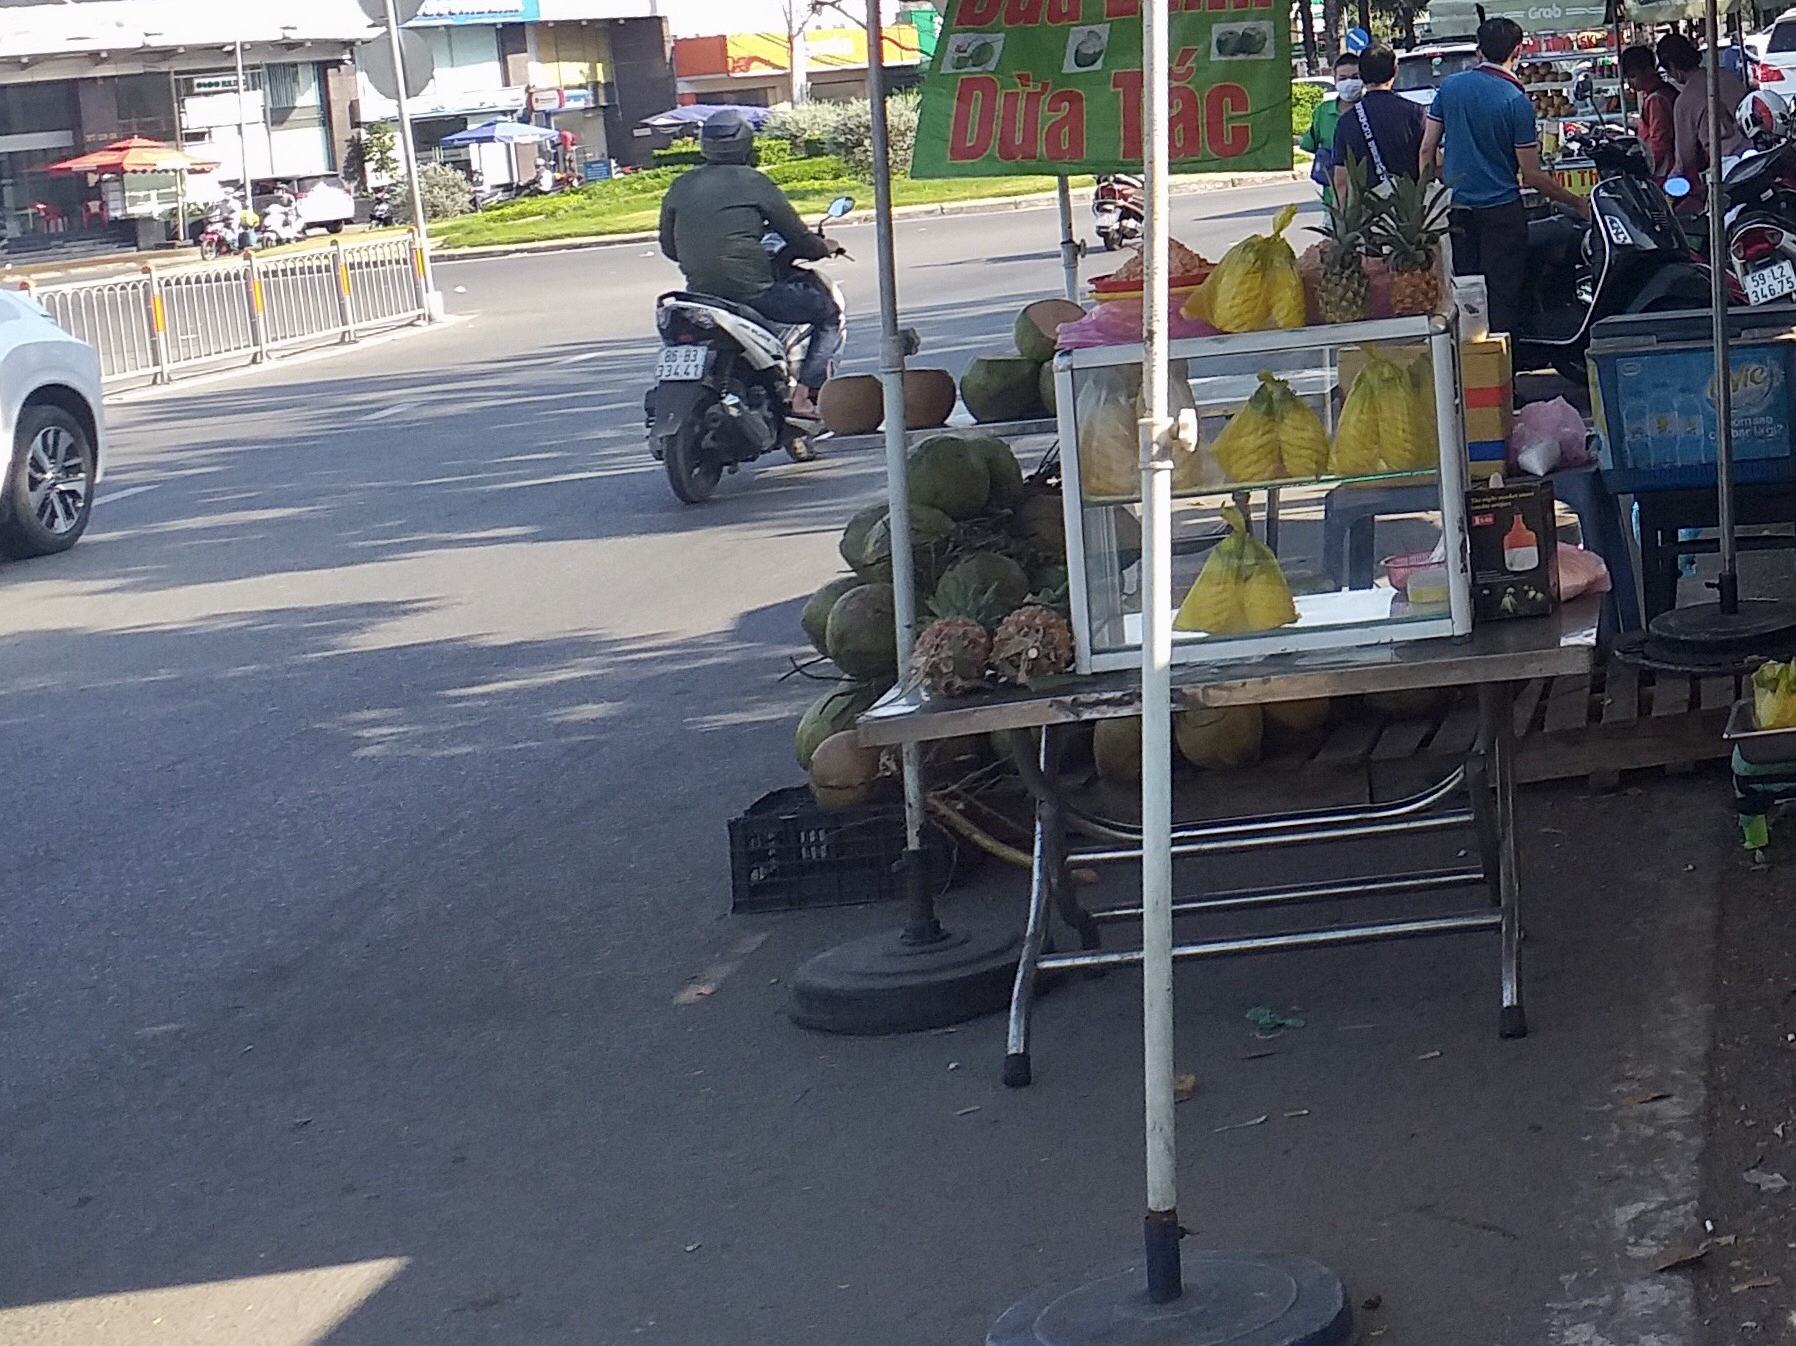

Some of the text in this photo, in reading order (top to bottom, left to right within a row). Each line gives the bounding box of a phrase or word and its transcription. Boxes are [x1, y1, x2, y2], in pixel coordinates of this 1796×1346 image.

[1528, 4, 1562, 20] Grab
[948, 71, 1086, 163] Dừa
[1752, 276, 1794, 303] 346.75
